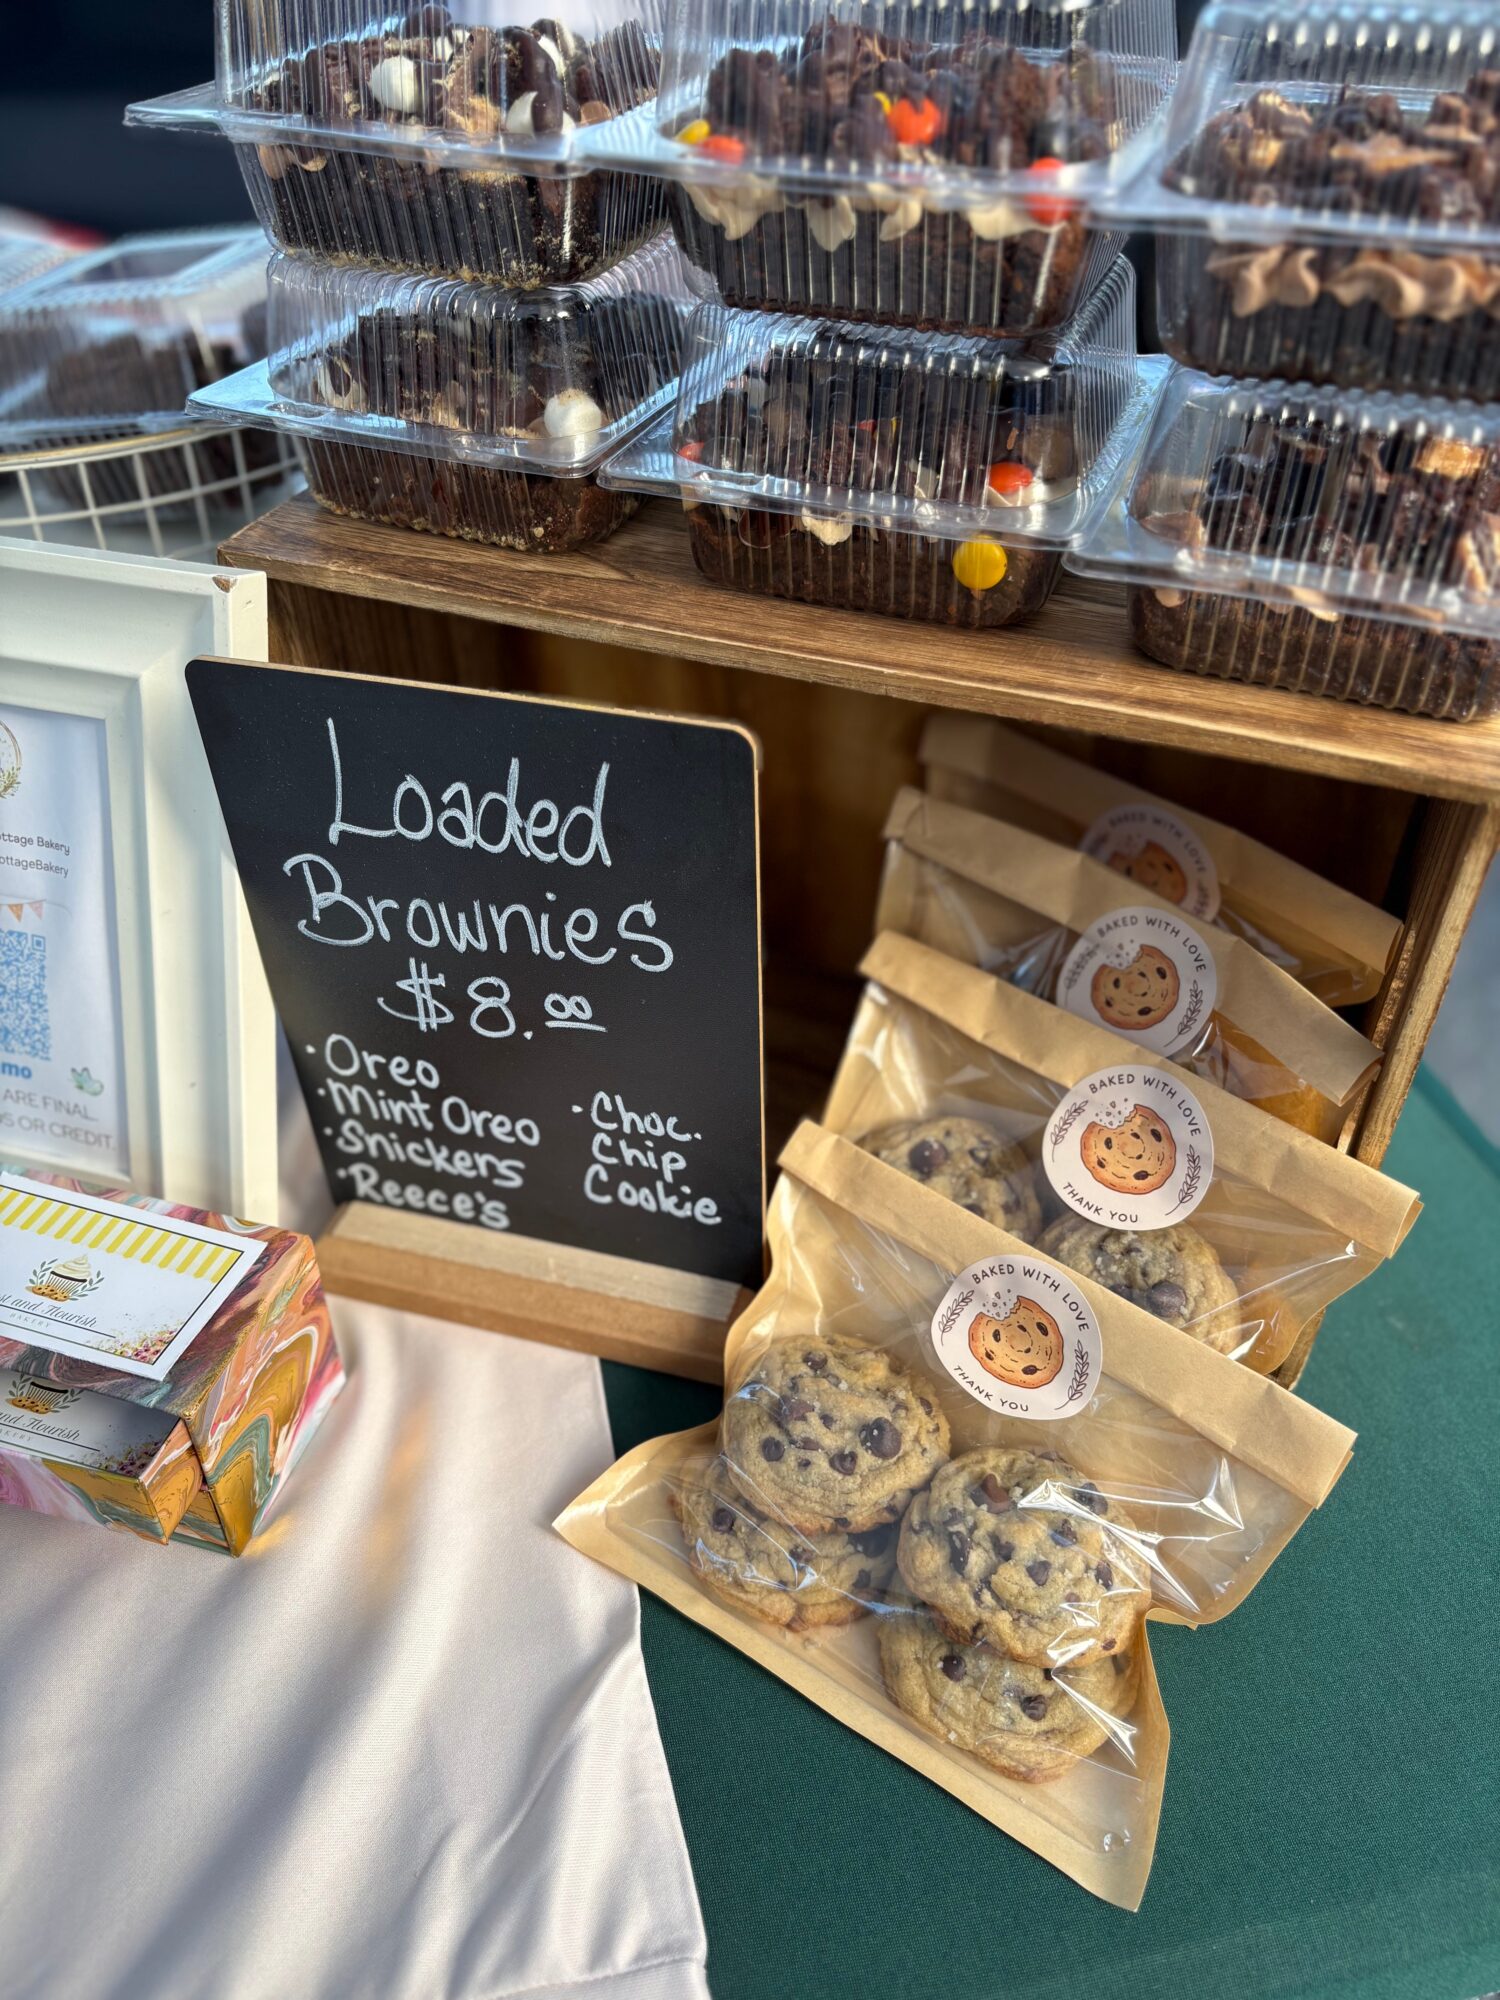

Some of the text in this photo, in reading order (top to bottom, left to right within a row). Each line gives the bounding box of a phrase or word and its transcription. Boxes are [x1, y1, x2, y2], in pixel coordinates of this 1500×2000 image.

[327, 717, 612, 867] Loaded
[0, 832, 70, 856] ttage Bakery
[282, 853, 674, 973] Brownies
[1097, 914, 1207, 973] BAKED WITH LOVE
[325, 1034, 439, 1089] Oreo
[3, 1088, 99, 1121] ARE FINAL
[18, 1115, 46, 1134] OR
[329, 1077, 540, 1146] Mint Oreo
[590, 1092, 702, 1142] Choc.
[1088, 1073, 1202, 1137] BAKED WITH LOVE
[336, 1118, 525, 1189] Snickers
[590, 1132, 688, 1183] Chip
[347, 1163, 511, 1230] Reece's
[583, 1165, 722, 1226] Cookie
[1063, 1182, 1139, 1223] THANK YOU
[10, 1298, 43, 1312] and
[42, 1304, 97, 1328] Flourish
[971, 1264, 1090, 1332] BAKED WITH LOVE
[953, 1364, 1029, 1412] THANK YOU
[23, 1417, 80, 1441] Flourish
